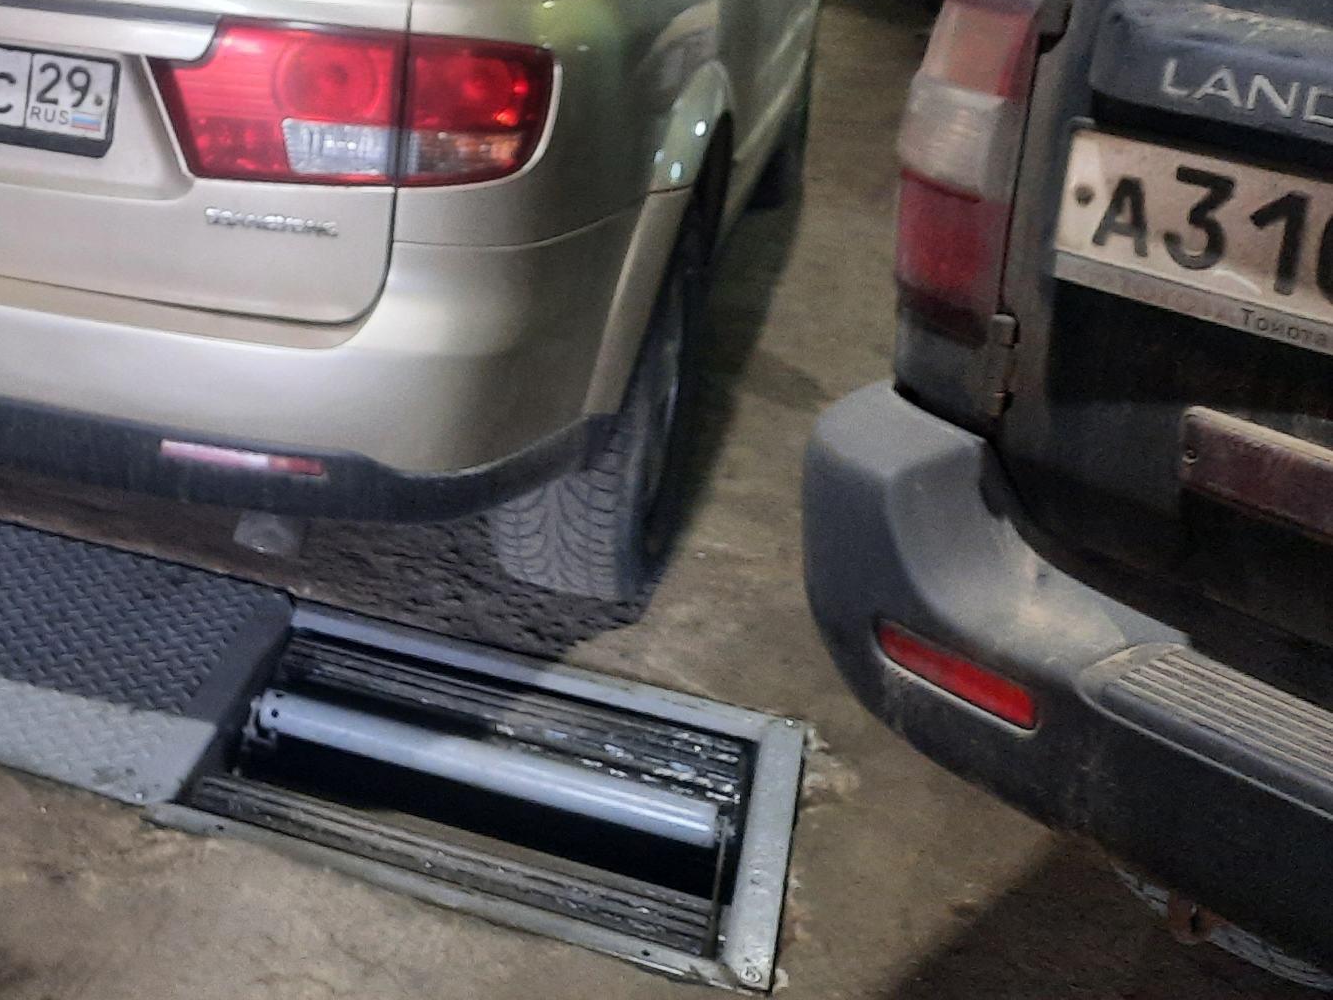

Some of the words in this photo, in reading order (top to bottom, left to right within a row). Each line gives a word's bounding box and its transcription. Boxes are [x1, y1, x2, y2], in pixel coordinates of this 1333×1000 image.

[35, 62, 92, 108] 29
[29, 106, 69, 126] RUS
[1092, 163, 1333, 306] А31
